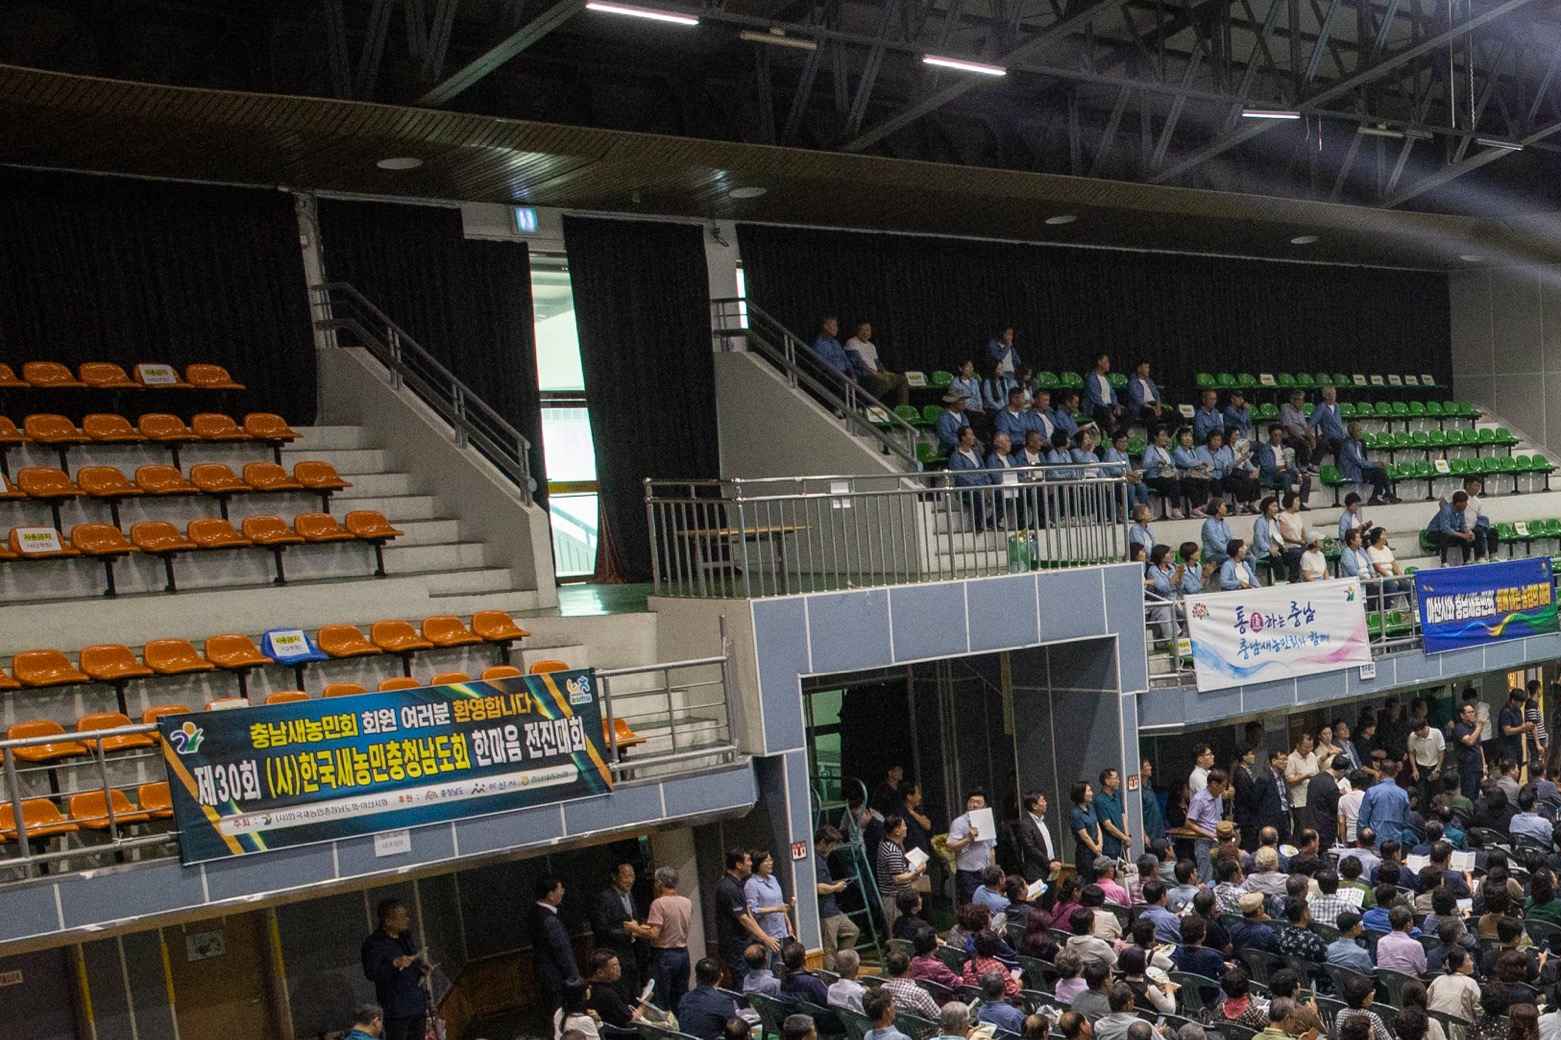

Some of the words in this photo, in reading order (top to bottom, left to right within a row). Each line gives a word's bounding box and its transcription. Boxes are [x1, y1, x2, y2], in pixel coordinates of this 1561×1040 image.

[250, 713, 359, 749] 충남새농민회
[361, 708, 397, 734] 회원
[401, 702, 451, 729] 여러분
[453, 692, 533, 723] 환영합니다
[194, 759, 263, 806] 제30회
[266, 732, 471, 799] (사)한국새농민충청남도회
[472, 724, 522, 767] 한마음
[524, 716, 587, 758] 전진대회
